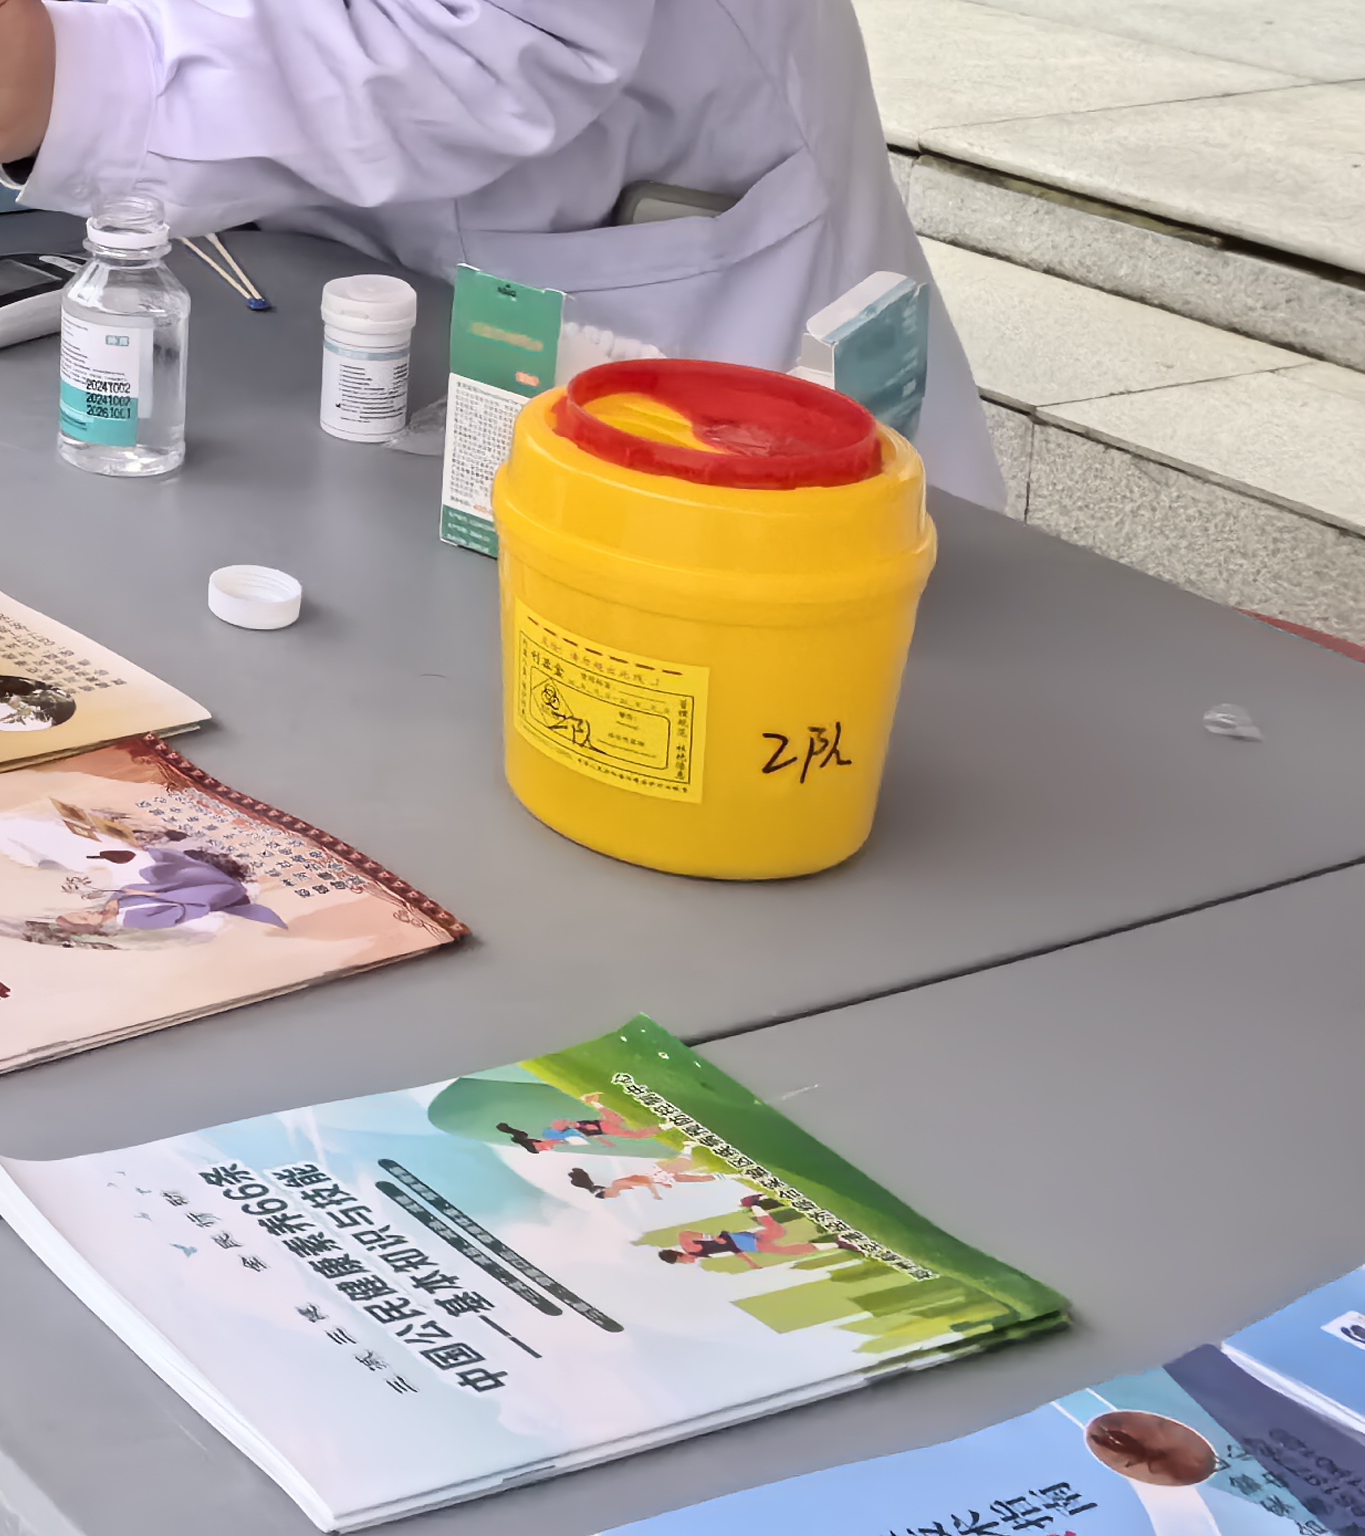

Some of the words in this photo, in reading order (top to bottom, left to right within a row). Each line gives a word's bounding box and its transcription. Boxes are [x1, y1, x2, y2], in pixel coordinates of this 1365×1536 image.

[156, 1186, 270, 1274] 全民行动
[194, 1160, 516, 1395] 中国公民健康素养66条
[602, 1071, 940, 1282] 郑州航空港经济综合实验区疾病预防控制中心
